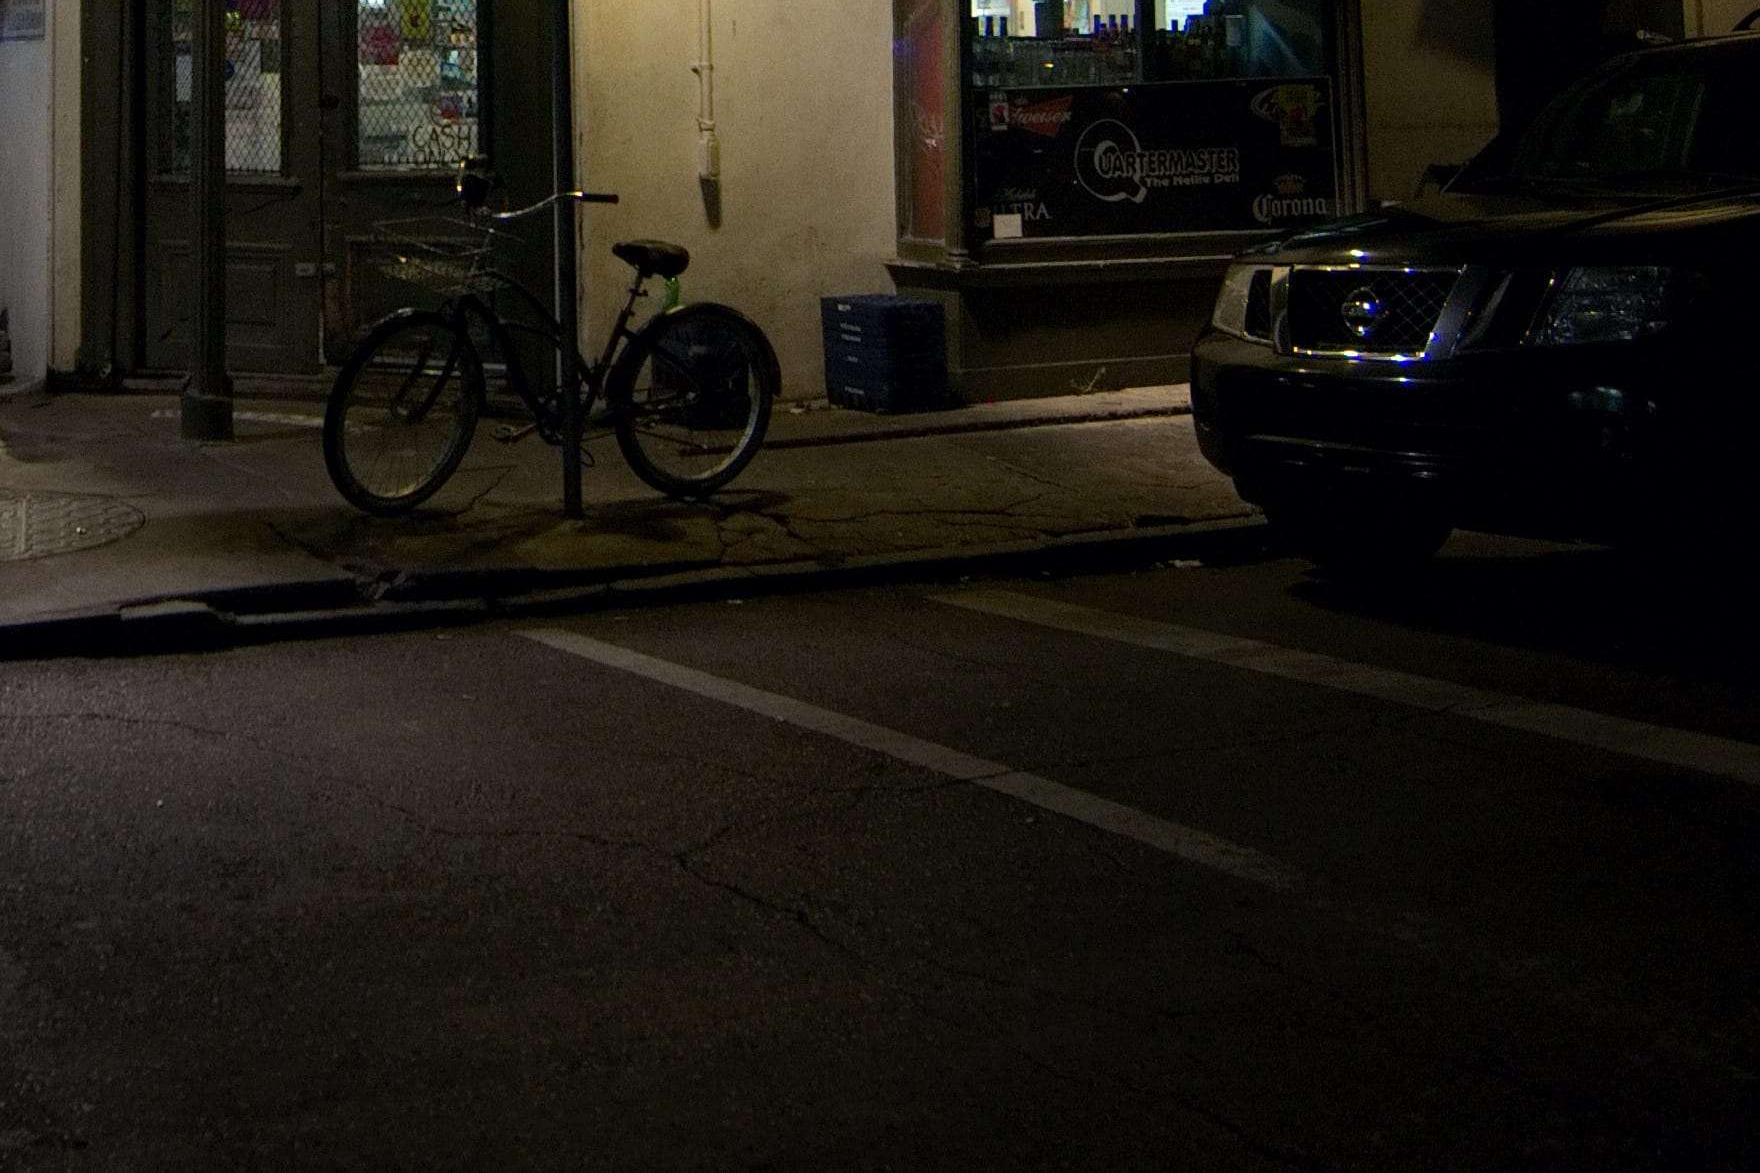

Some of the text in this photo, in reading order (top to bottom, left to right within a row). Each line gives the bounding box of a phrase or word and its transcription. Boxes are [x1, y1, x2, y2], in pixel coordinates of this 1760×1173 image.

[412, 124, 471, 153] CASH
[1144, 177, 1170, 188] The
[1214, 173, 1240, 184] Deli
[1251, 192, 1328, 225] Corona
